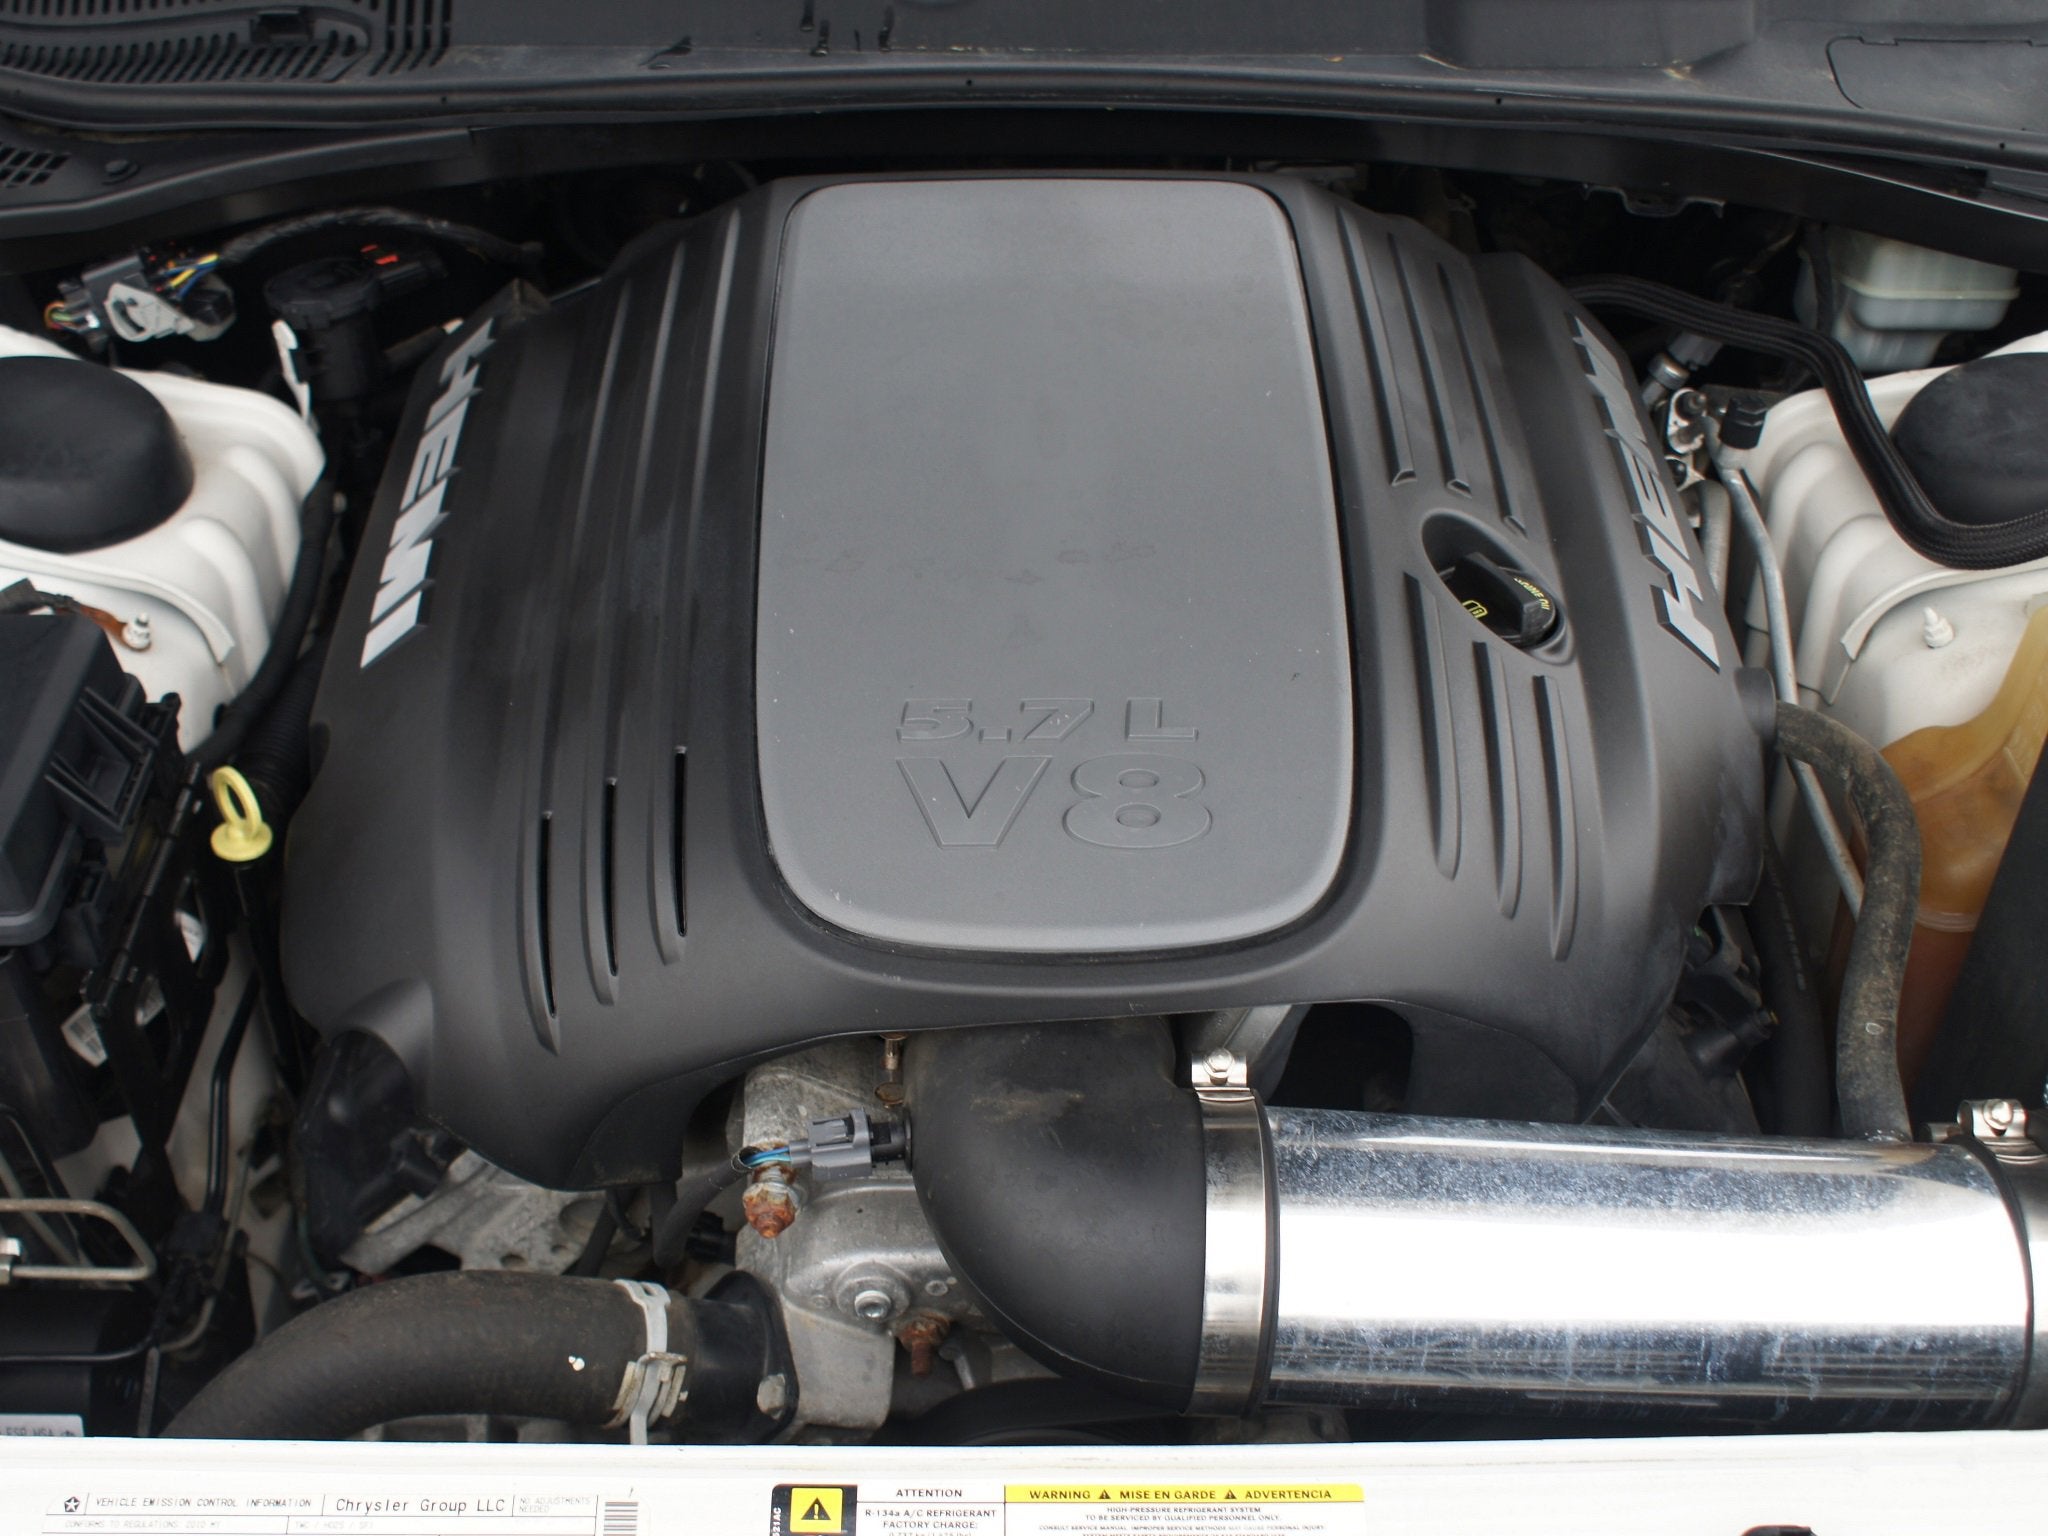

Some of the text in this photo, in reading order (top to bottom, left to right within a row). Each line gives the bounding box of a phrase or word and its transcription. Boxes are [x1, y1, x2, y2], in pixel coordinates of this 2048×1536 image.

[361, 318, 496, 669] HEMI
[1574, 317, 1720, 674] HEMI
[895, 752, 1213, 850] V8
[896, 1489, 963, 1498] ATTENTION
[1029, 1490, 1091, 1499] WARNING
[1119, 1490, 1217, 1499] MISE EN GARDE
[1244, 1490, 1333, 1499] ADVERTENCIA
[96, 1497, 312, 1508] VEHICLE EMISSION CONTROL INFORMATION
[336, 1499, 505, 1517] Chrysler Group LLC
[865, 1509, 996, 1518] R-134a A/C REFRIGERANT
[883, 1521, 929, 1529] FACTORY
